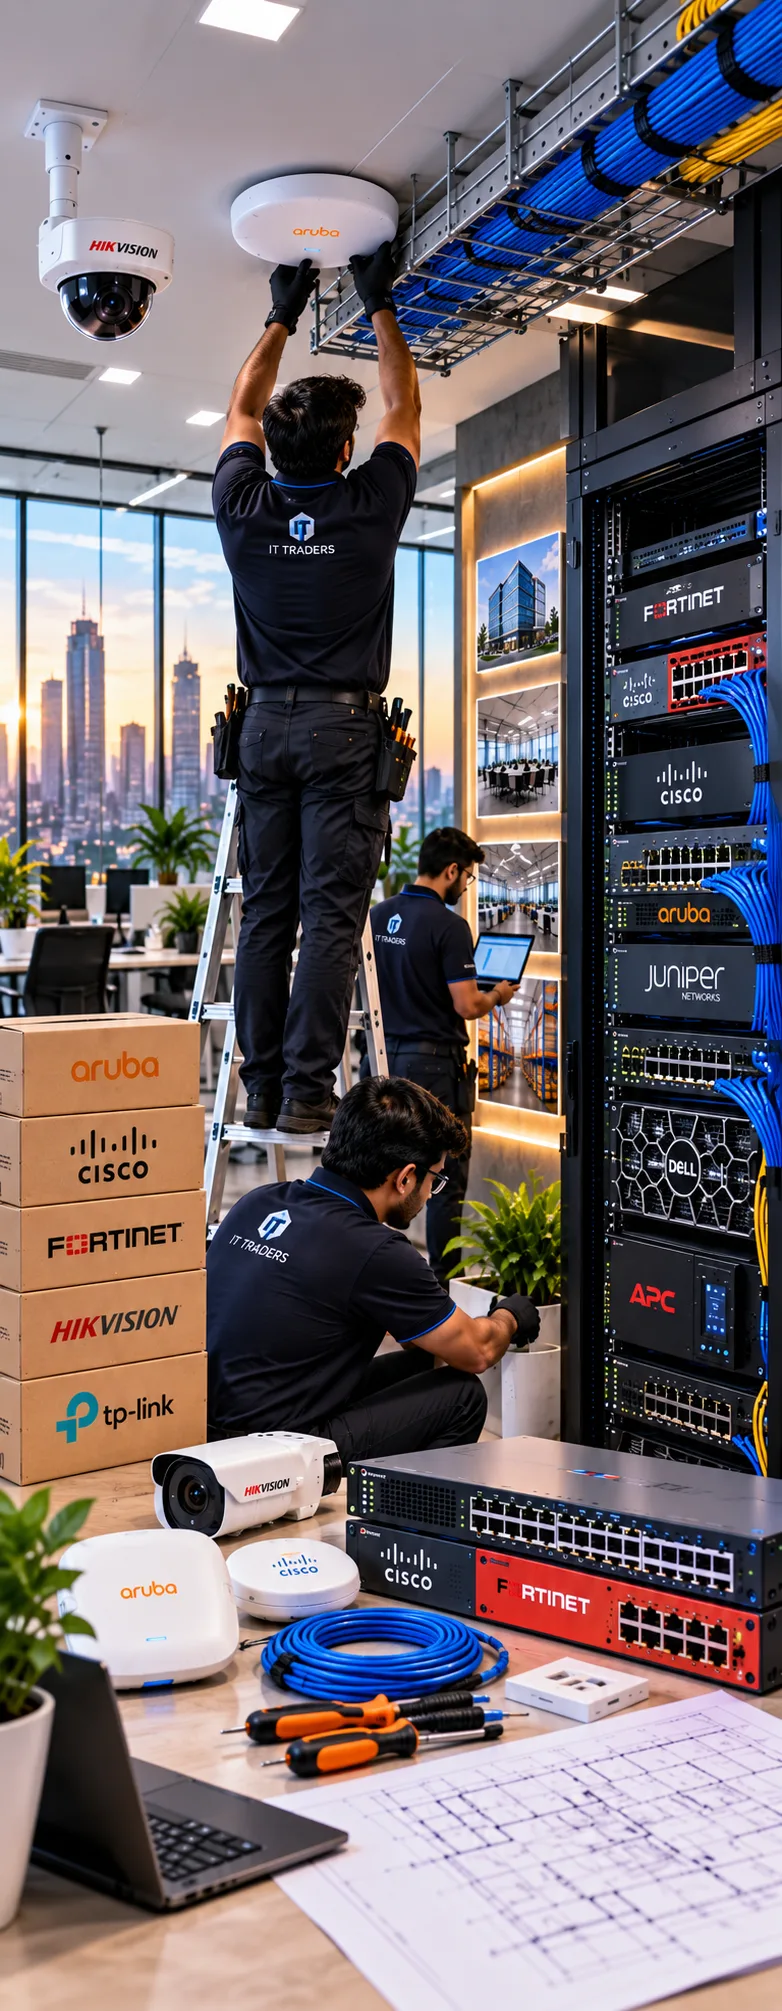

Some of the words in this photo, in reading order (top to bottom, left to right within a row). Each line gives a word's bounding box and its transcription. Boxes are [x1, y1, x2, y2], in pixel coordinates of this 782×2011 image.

[293, 226, 340, 238] aruba
[89, 240, 159, 260] HIKVISION
[269, 544, 280, 555] IT
[282, 544, 335, 555] TRADERS
[643, 586, 724, 622] FORTINET
[661, 788, 702, 805] CISCO
[658, 902, 710, 923] aruba
[681, 993, 721, 1002] NETWORKS
[71, 1051, 160, 1083] aruba
[78, 1160, 149, 1184] CISCO
[668, 1159, 697, 1177] DELL
[48, 1222, 183, 1259] FORTINET
[229, 1234, 242, 1246] IT
[242, 1237, 289, 1263] TRADERS
[629, 1283, 676, 1314] APC
[50, 1306, 178, 1344] HIKVISION
[103, 1393, 174, 1429] tp-link
[244, 1478, 290, 1497] HIKVISION
[279, 1566, 319, 1577] CISCO
[385, 1568, 432, 1591] CISCO
[120, 1581, 177, 1600] aruba
